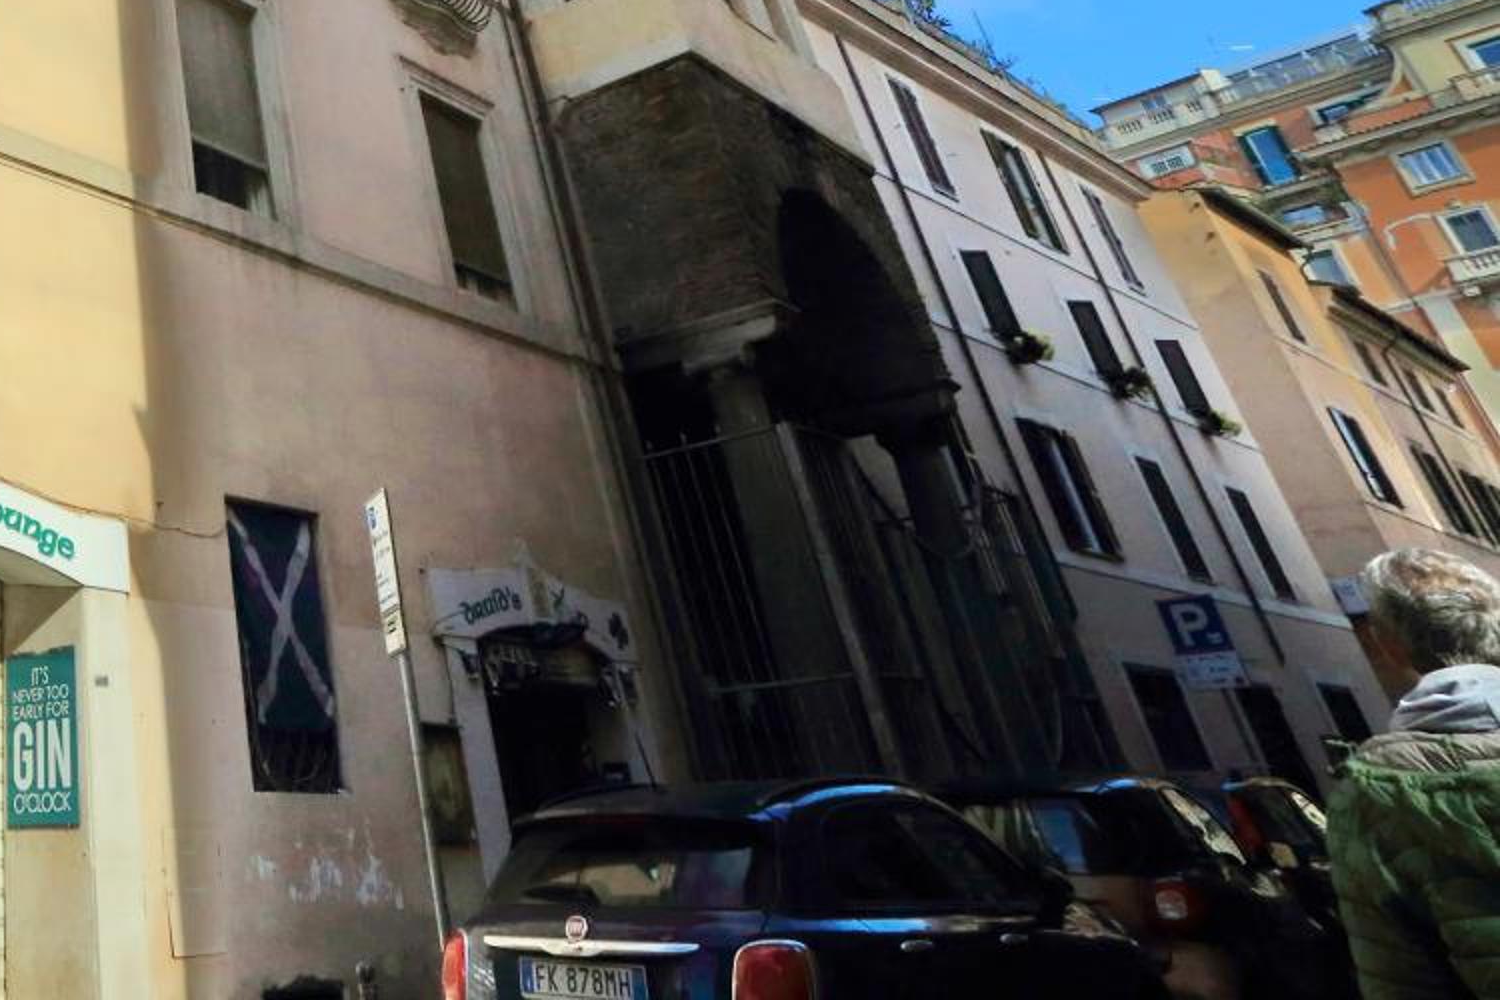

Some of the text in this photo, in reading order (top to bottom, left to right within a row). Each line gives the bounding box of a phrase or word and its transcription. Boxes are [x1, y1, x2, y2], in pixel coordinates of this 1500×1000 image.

[1169, 602, 1208, 647] P
[31, 666, 49, 686] IT'S
[12, 684, 69, 703] NEVER TOO
[12, 702, 69, 722] EARLY FOR
[13, 717, 71, 791] GIN
[13, 791, 72, 815] O'CLOCK
[535, 965, 632, 996] FK 878MH
